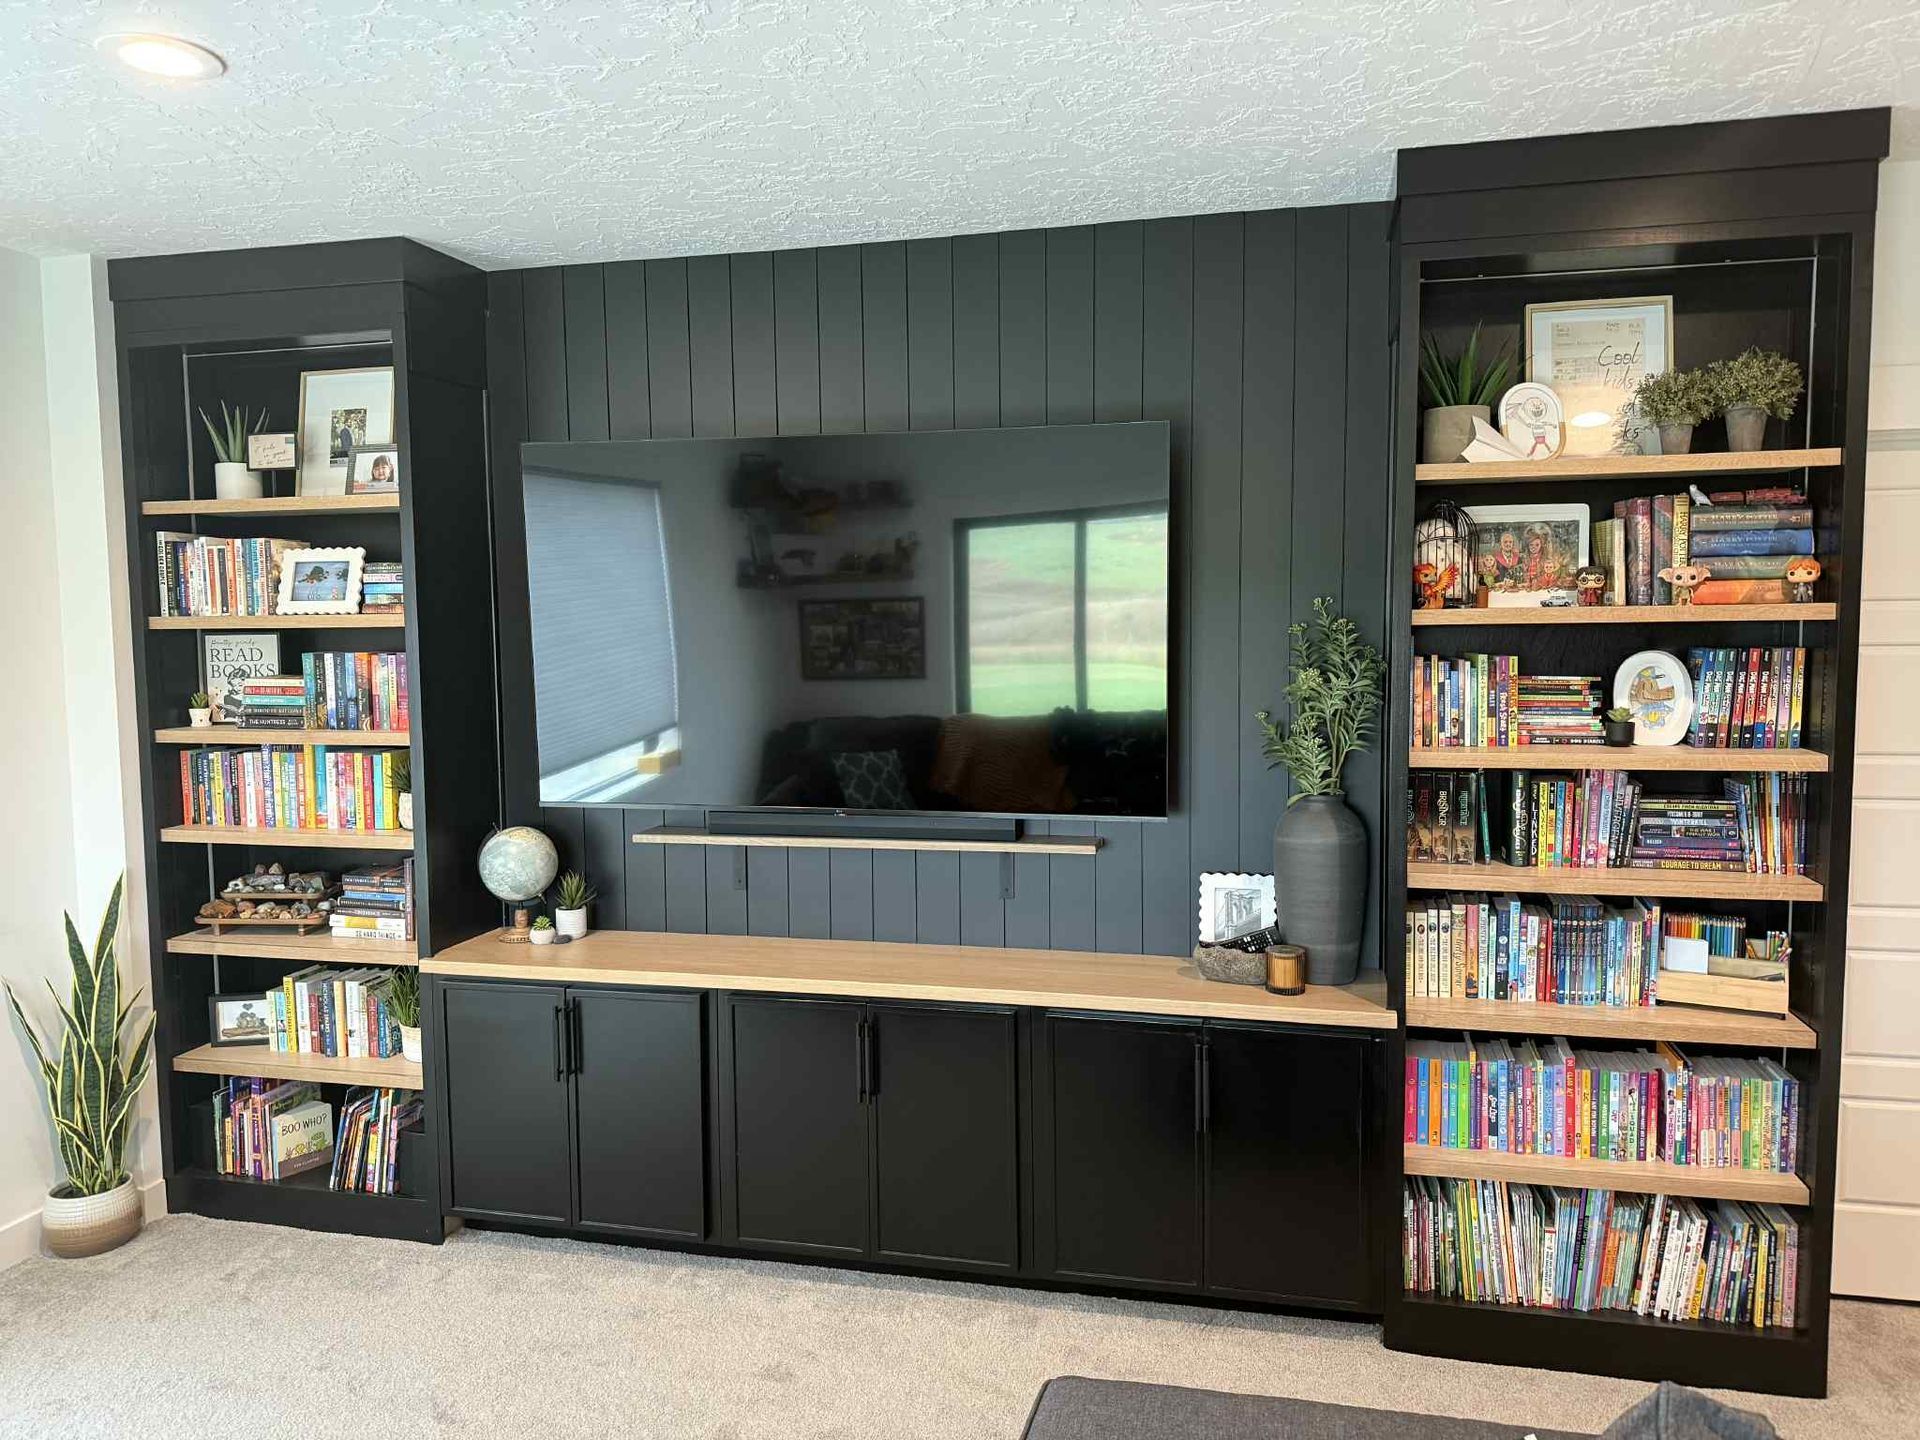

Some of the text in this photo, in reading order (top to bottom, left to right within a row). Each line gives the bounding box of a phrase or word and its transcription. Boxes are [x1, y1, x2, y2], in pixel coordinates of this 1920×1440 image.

[1598, 342, 1641, 366] Cool
[1679, 512, 1688, 536] HARRY
[210, 647, 263, 662] READ
[210, 663, 276, 679] BOOKS
[1705, 671, 1713, 683] DOG
[1714, 671, 1722, 683] DOG
[1725, 671, 1734, 694] DOG MAN
[1738, 671, 1746, 683] DOG
[1760, 671, 1769, 694] DOG MAN
[1436, 790, 1449, 827] BRISINGR
[1610, 792, 1625, 848] DIVERGENT
[1531, 802, 1539, 856] LINKED
[1661, 860, 1722, 870] COURAGE TO DREAM
[323, 1014, 331, 1034] SPARKS
[1489, 1095, 1498, 1123] Sea Legs
[281, 1112, 328, 1136] BOO WHO?
